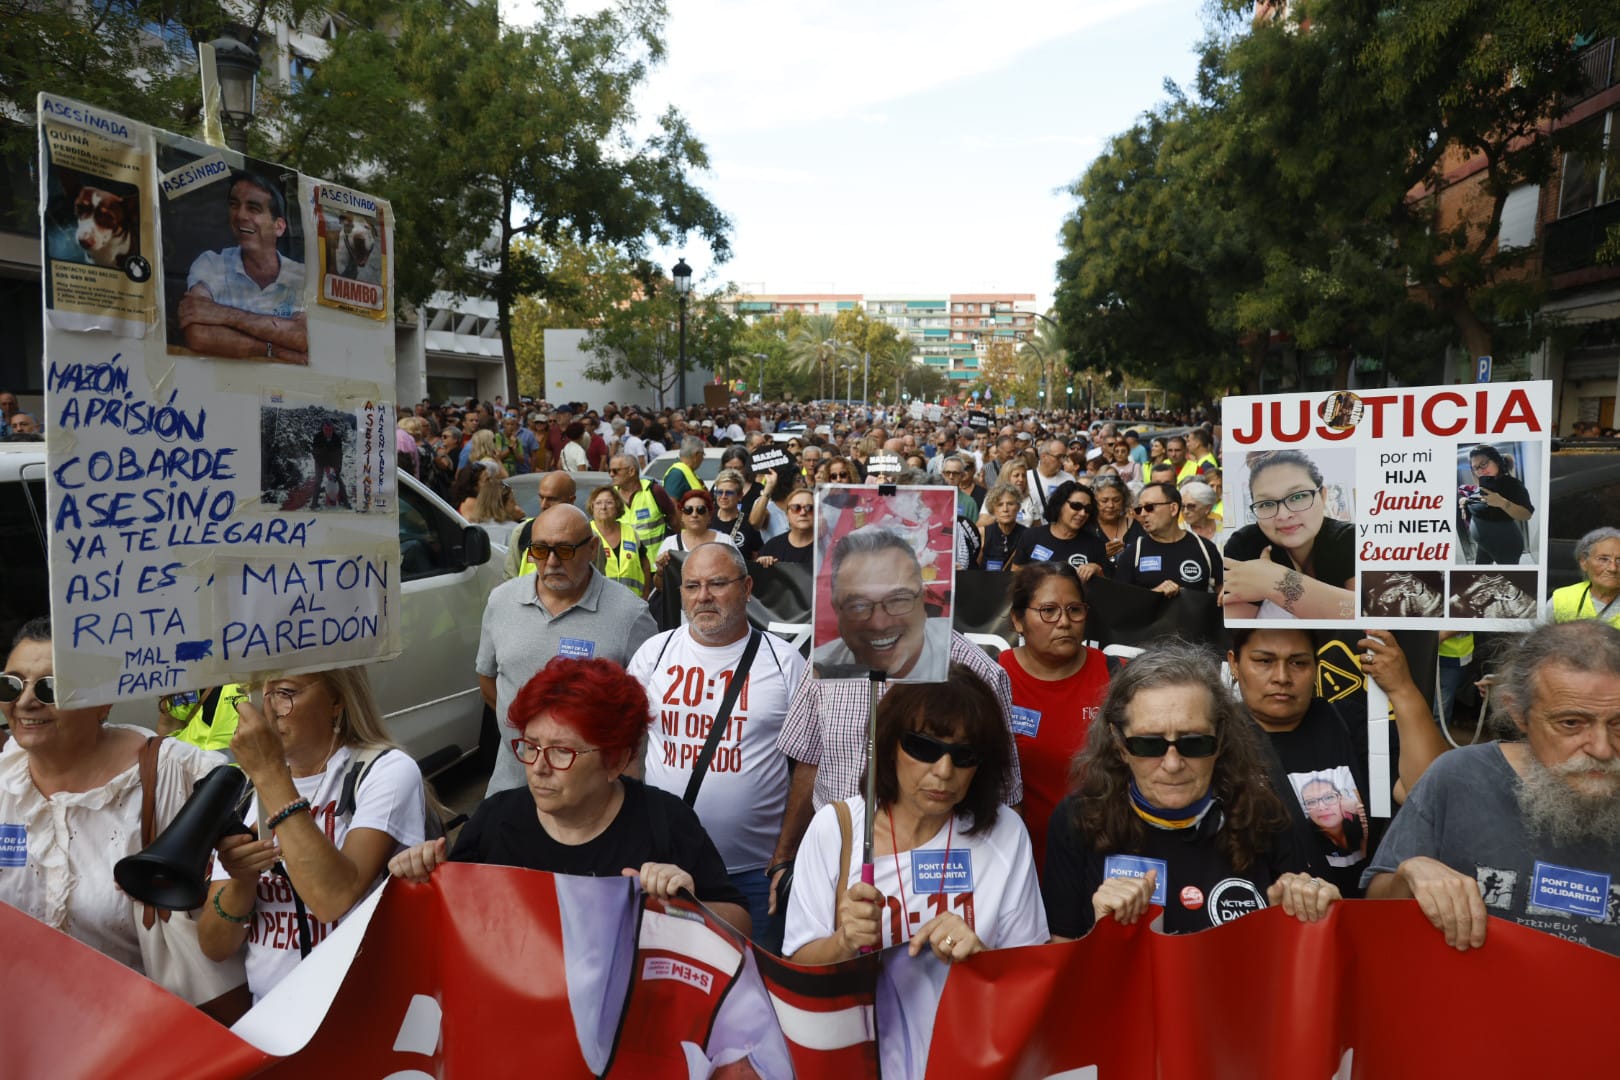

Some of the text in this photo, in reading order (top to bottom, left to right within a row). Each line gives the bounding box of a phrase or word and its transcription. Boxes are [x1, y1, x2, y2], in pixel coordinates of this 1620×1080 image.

[43, 99, 128, 138] ASESINADA
[50, 130, 90, 147] QUINA
[164, 160, 227, 194] ASESINADO
[320, 187, 377, 212] ASESINADO
[331, 278, 377, 304] MAMBO
[1479, 359, 1488, 381] P
[1232, 389, 1542, 445] JUSTICIA
[54, 447, 238, 490] COBARDE
[1380, 448, 1432, 467] por mi
[1385, 469, 1427, 484] HIJA
[55, 481, 236, 533] ASESINO
[1369, 490, 1444, 516] Janine
[66, 518, 317, 564] YA TE LLEGARÁ
[1360, 520, 1452, 538] y mi NIETA
[1359, 541, 1452, 561] Escarlett
[66, 560, 124, 604] ASÍ
[242, 555, 387, 595] MATÓN
[289, 593, 326, 616] AL
[73, 607, 186, 649] RATA
[222, 606, 378, 661] PAREDÓN
[125, 647, 170, 669] MAL
[663, 664, 751, 711] 20:11
[661, 710, 748, 742] NI OBIT
[918, 863, 940, 871] PONT
[919, 871, 967, 880] SOLIDARITAT
[1110, 868, 1133, 877] PONT
[1540, 886, 1602, 904] SOLIDARITAT
[1541, 877, 1599, 894] PONT DE LA
[1516, 917, 1578, 934] PIRINEUS
[672, 963, 709, 986] S+EM
